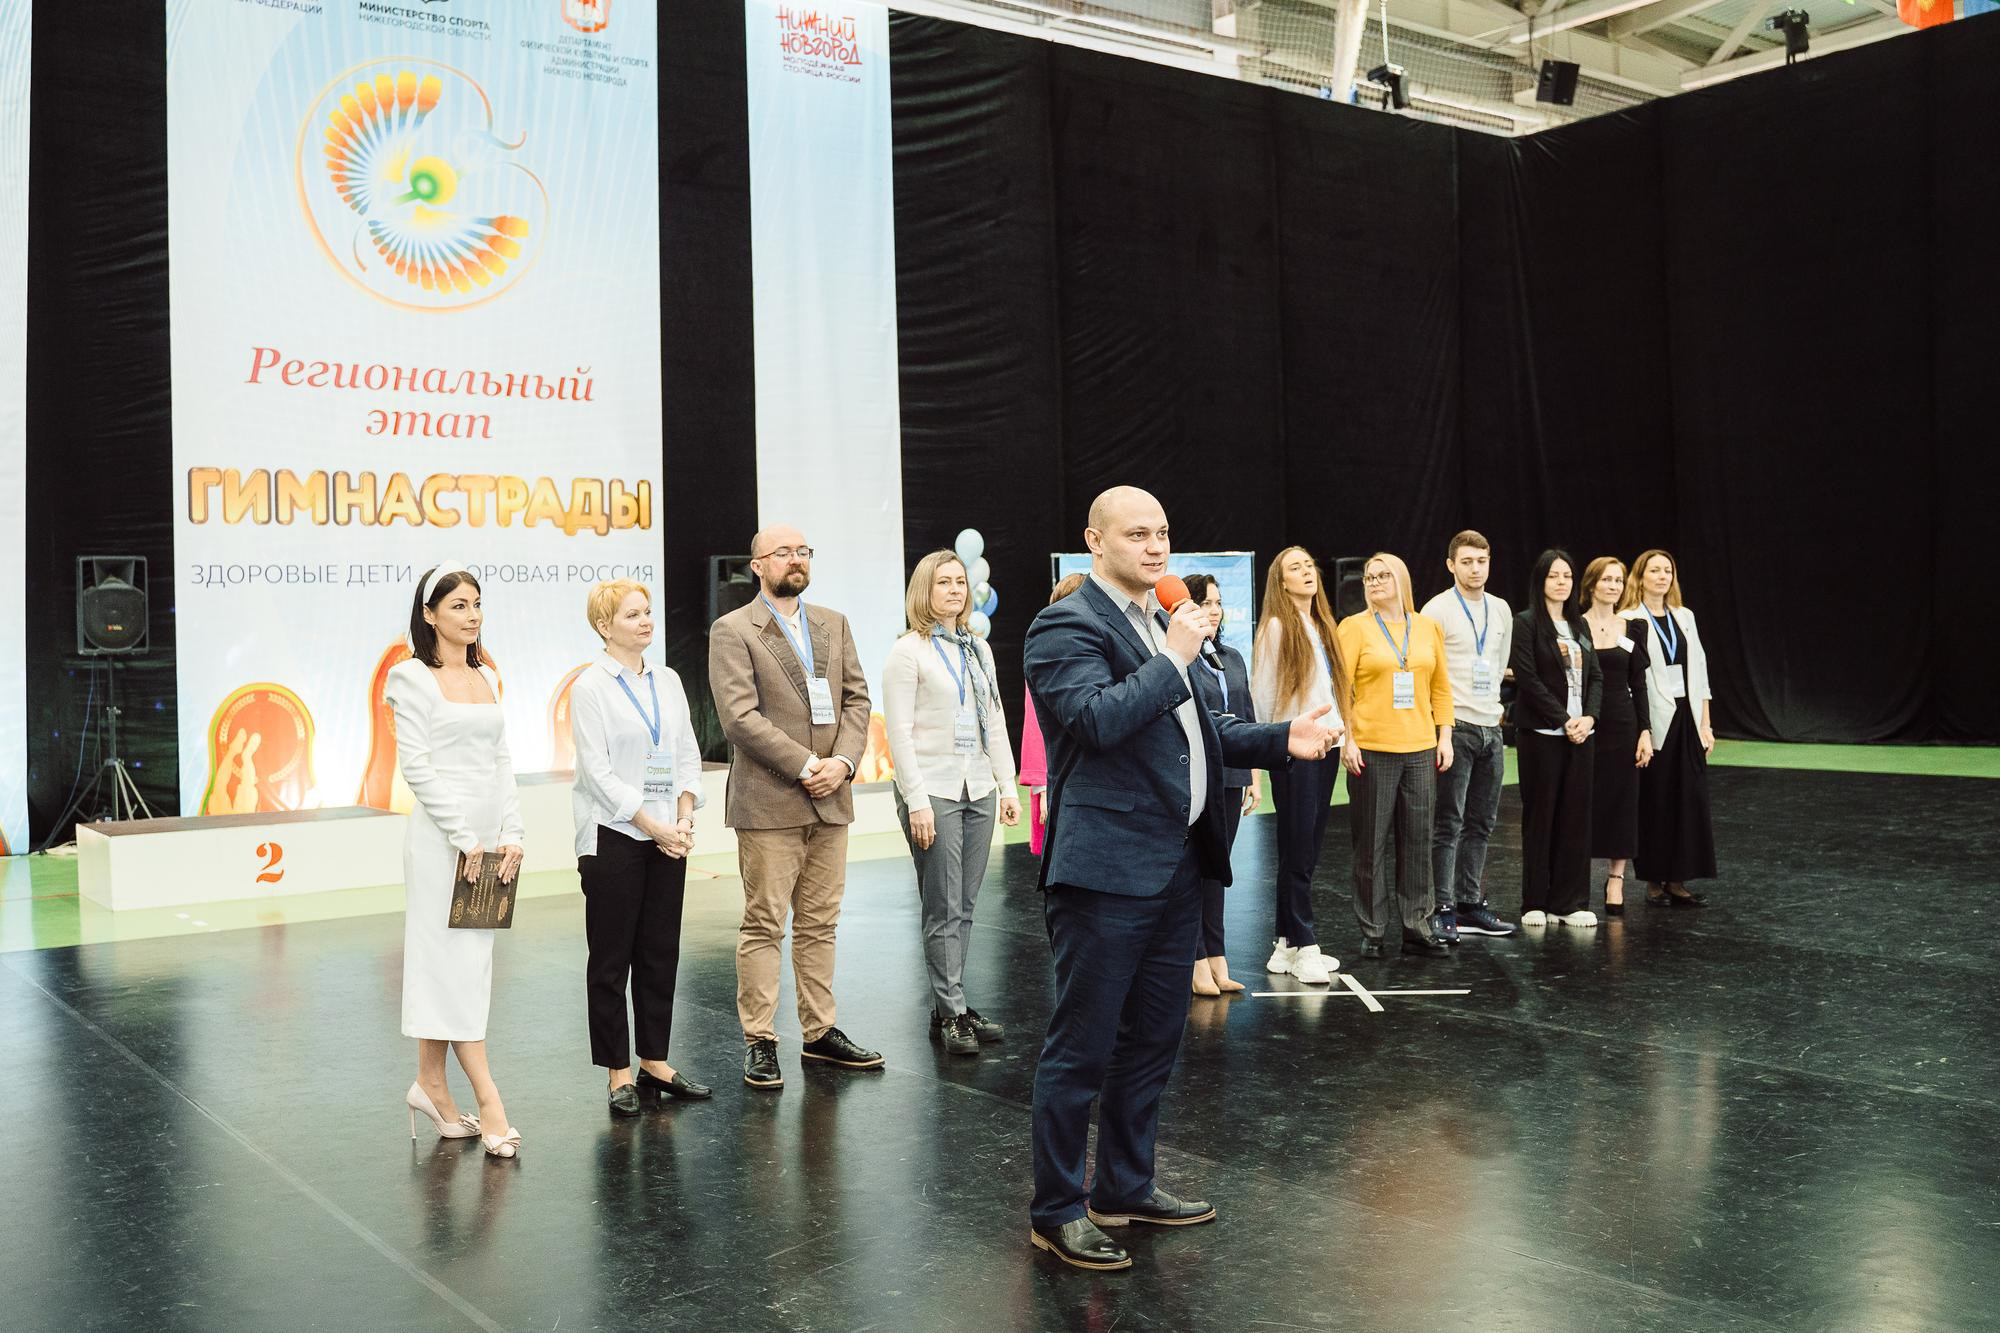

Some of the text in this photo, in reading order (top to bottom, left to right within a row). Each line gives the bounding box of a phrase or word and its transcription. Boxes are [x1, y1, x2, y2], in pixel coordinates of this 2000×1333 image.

[359, 2, 491, 31] МИНИСТЕРСТВО СПОРТА
[359, 13, 492, 41] НИЖЕГОРОДСКОЙ ОБЛАСТИ
[244, 346, 595, 402] Региональный
[365, 408, 493, 439] этап
[187, 466, 653, 537] ГИМНАСТРАДЫ
[191, 564, 339, 588] ЗДОРОВЫЕ
[346, 564, 412, 588] ДЕТИ
[434, 564, 559, 583] ОРОВАЯ
[567, 564, 653, 583] РОССИЯ
[256, 842, 285, 884] 2
